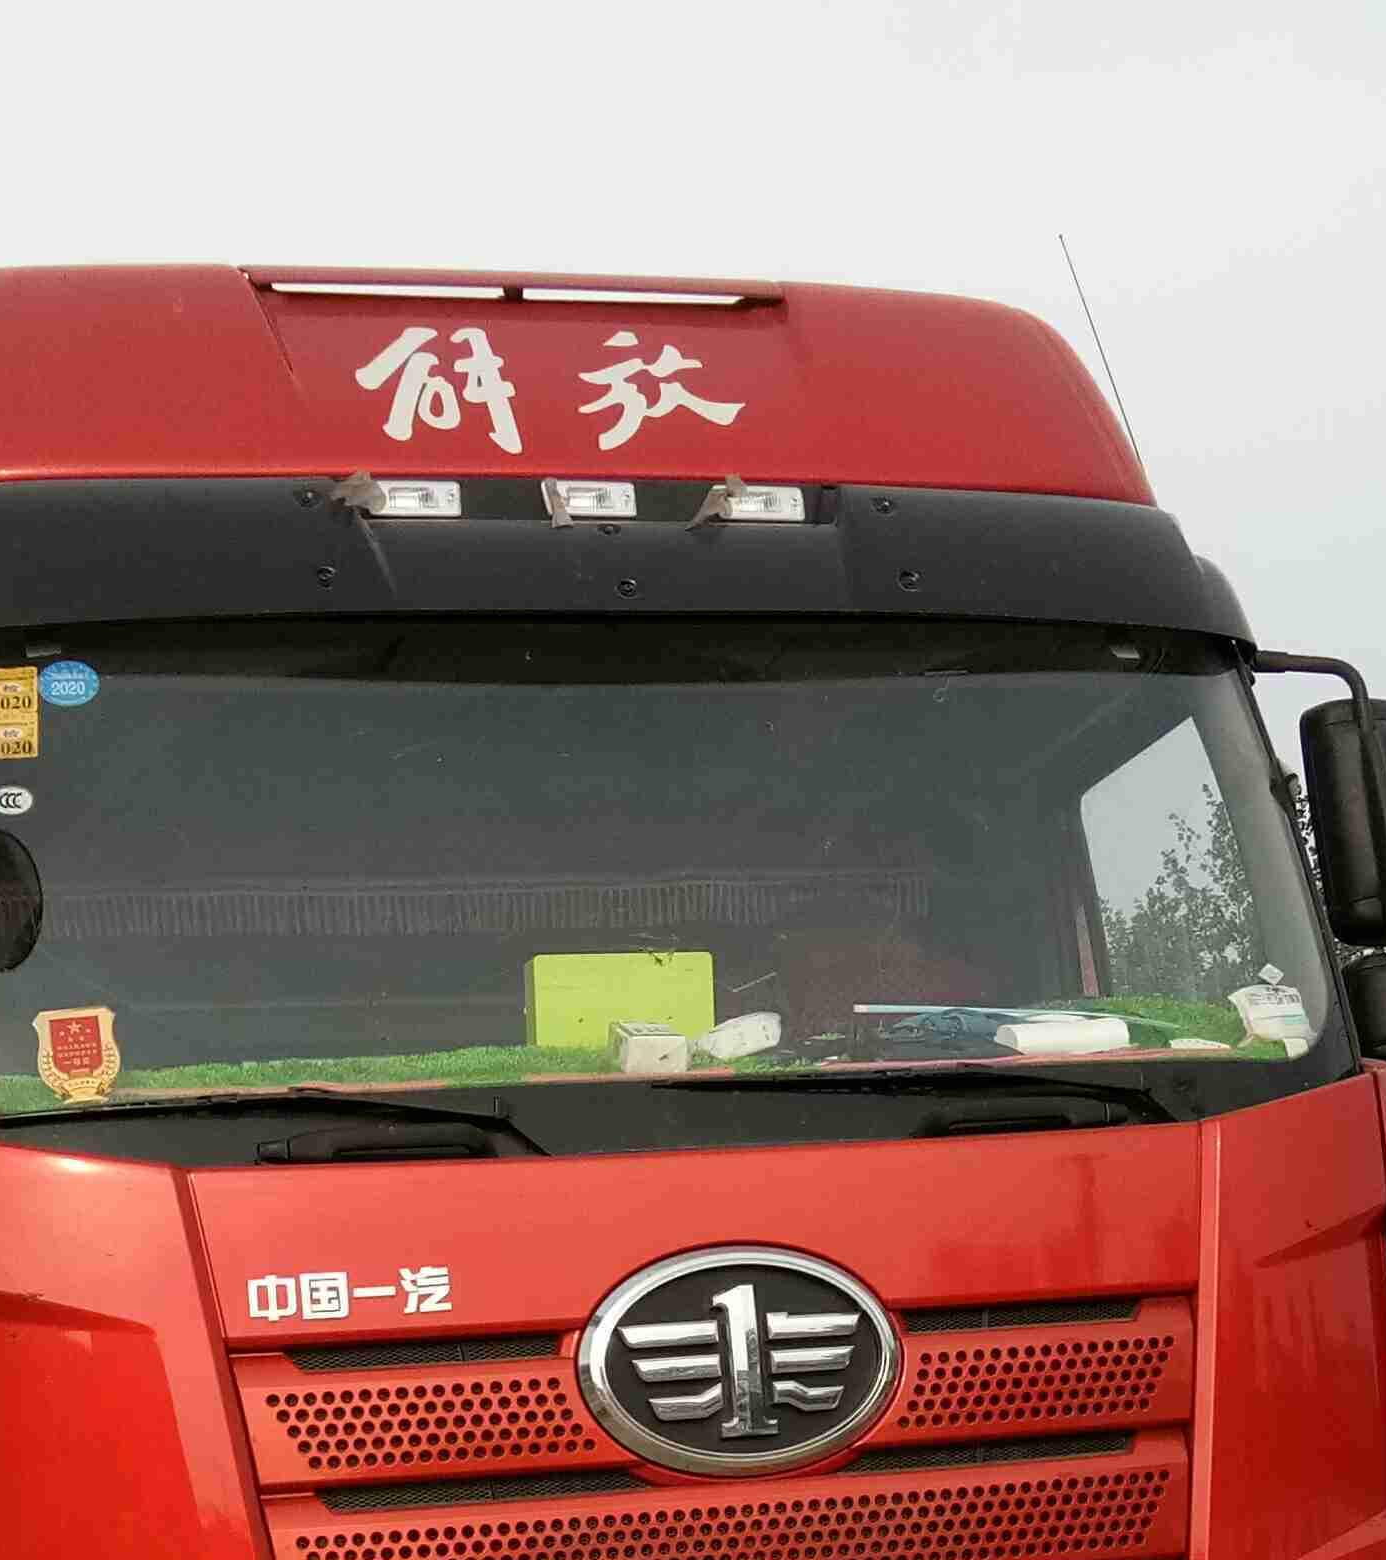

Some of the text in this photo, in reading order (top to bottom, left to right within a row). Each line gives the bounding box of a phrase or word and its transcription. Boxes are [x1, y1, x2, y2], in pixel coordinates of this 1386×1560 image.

[355, 327, 746, 455] 解放
[51, 681, 85, 695] 2020
[247, 1267, 452, 1322] 中国一汽
